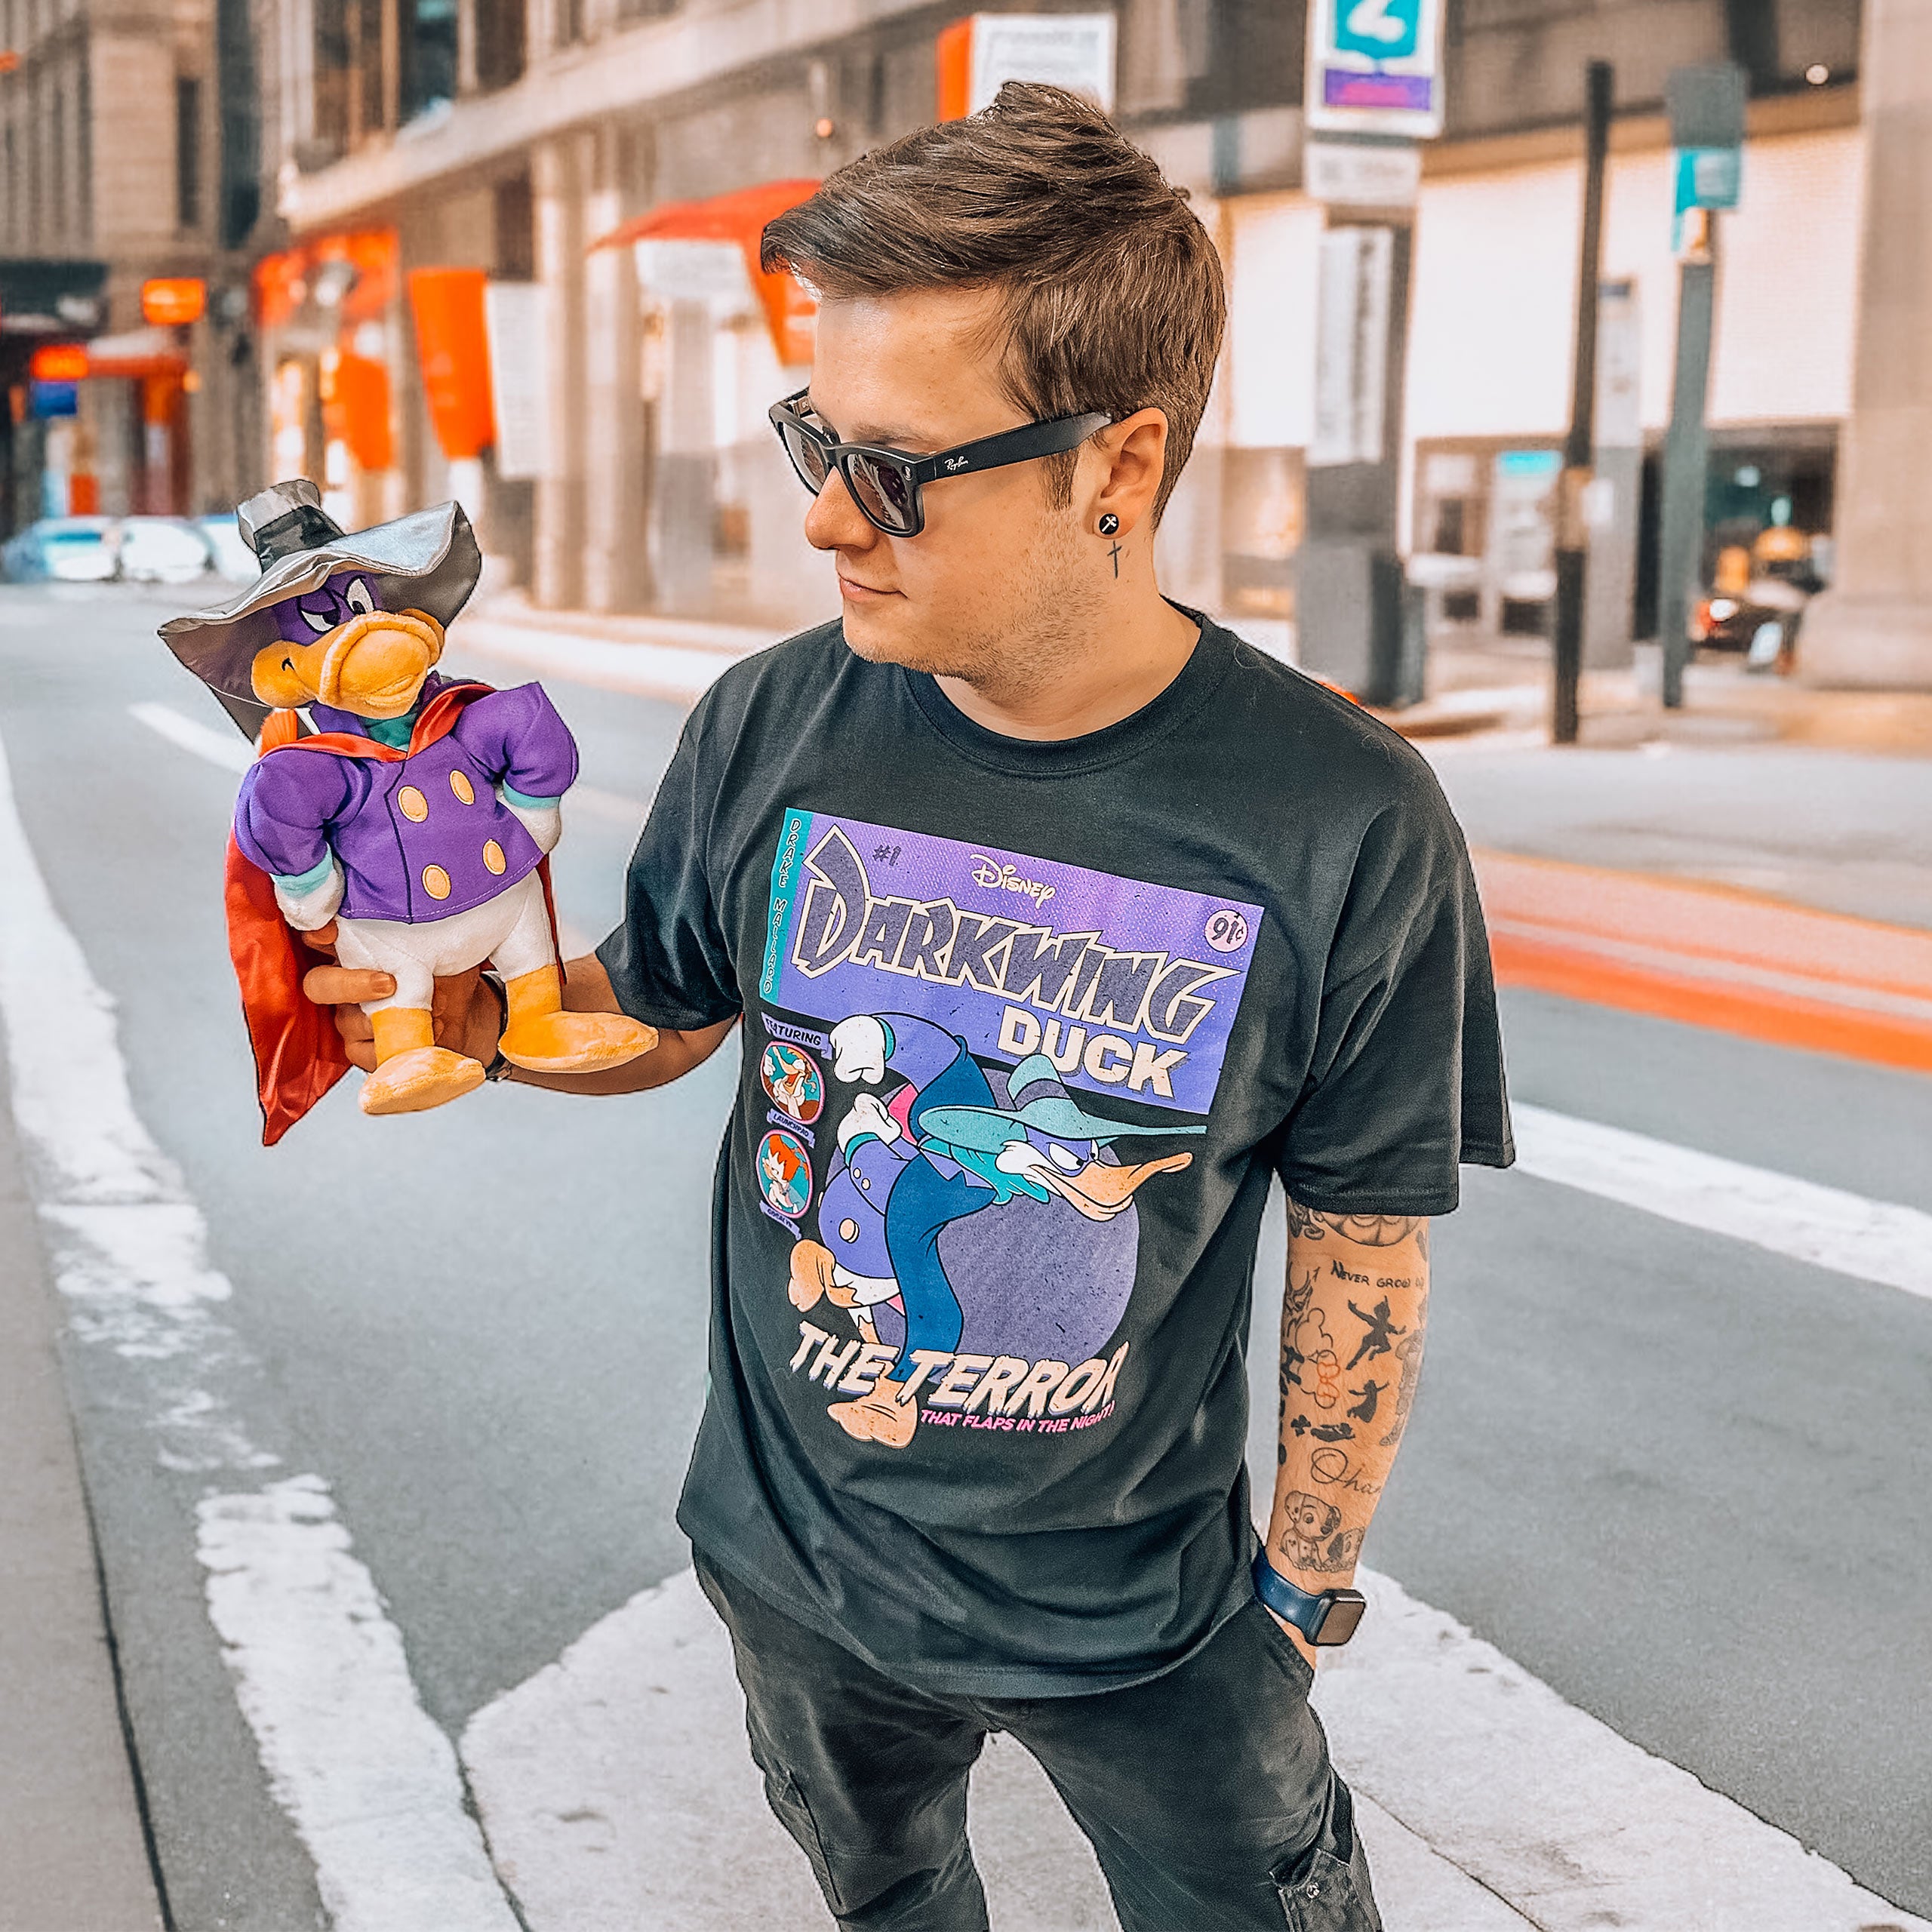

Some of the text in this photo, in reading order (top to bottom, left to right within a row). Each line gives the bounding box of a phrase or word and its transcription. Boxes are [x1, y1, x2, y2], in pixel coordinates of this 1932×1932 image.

[872, 844, 902, 866] #1
[763, 818, 801, 993] DRAKE MALLARD
[791, 824, 1241, 1044] DARKWING
[997, 1004, 1189, 1099] DUCK
[789, 1320, 900, 1394] THE
[920, 1400, 1115, 1433] THAT FLAPS IN THE NIGHT!
